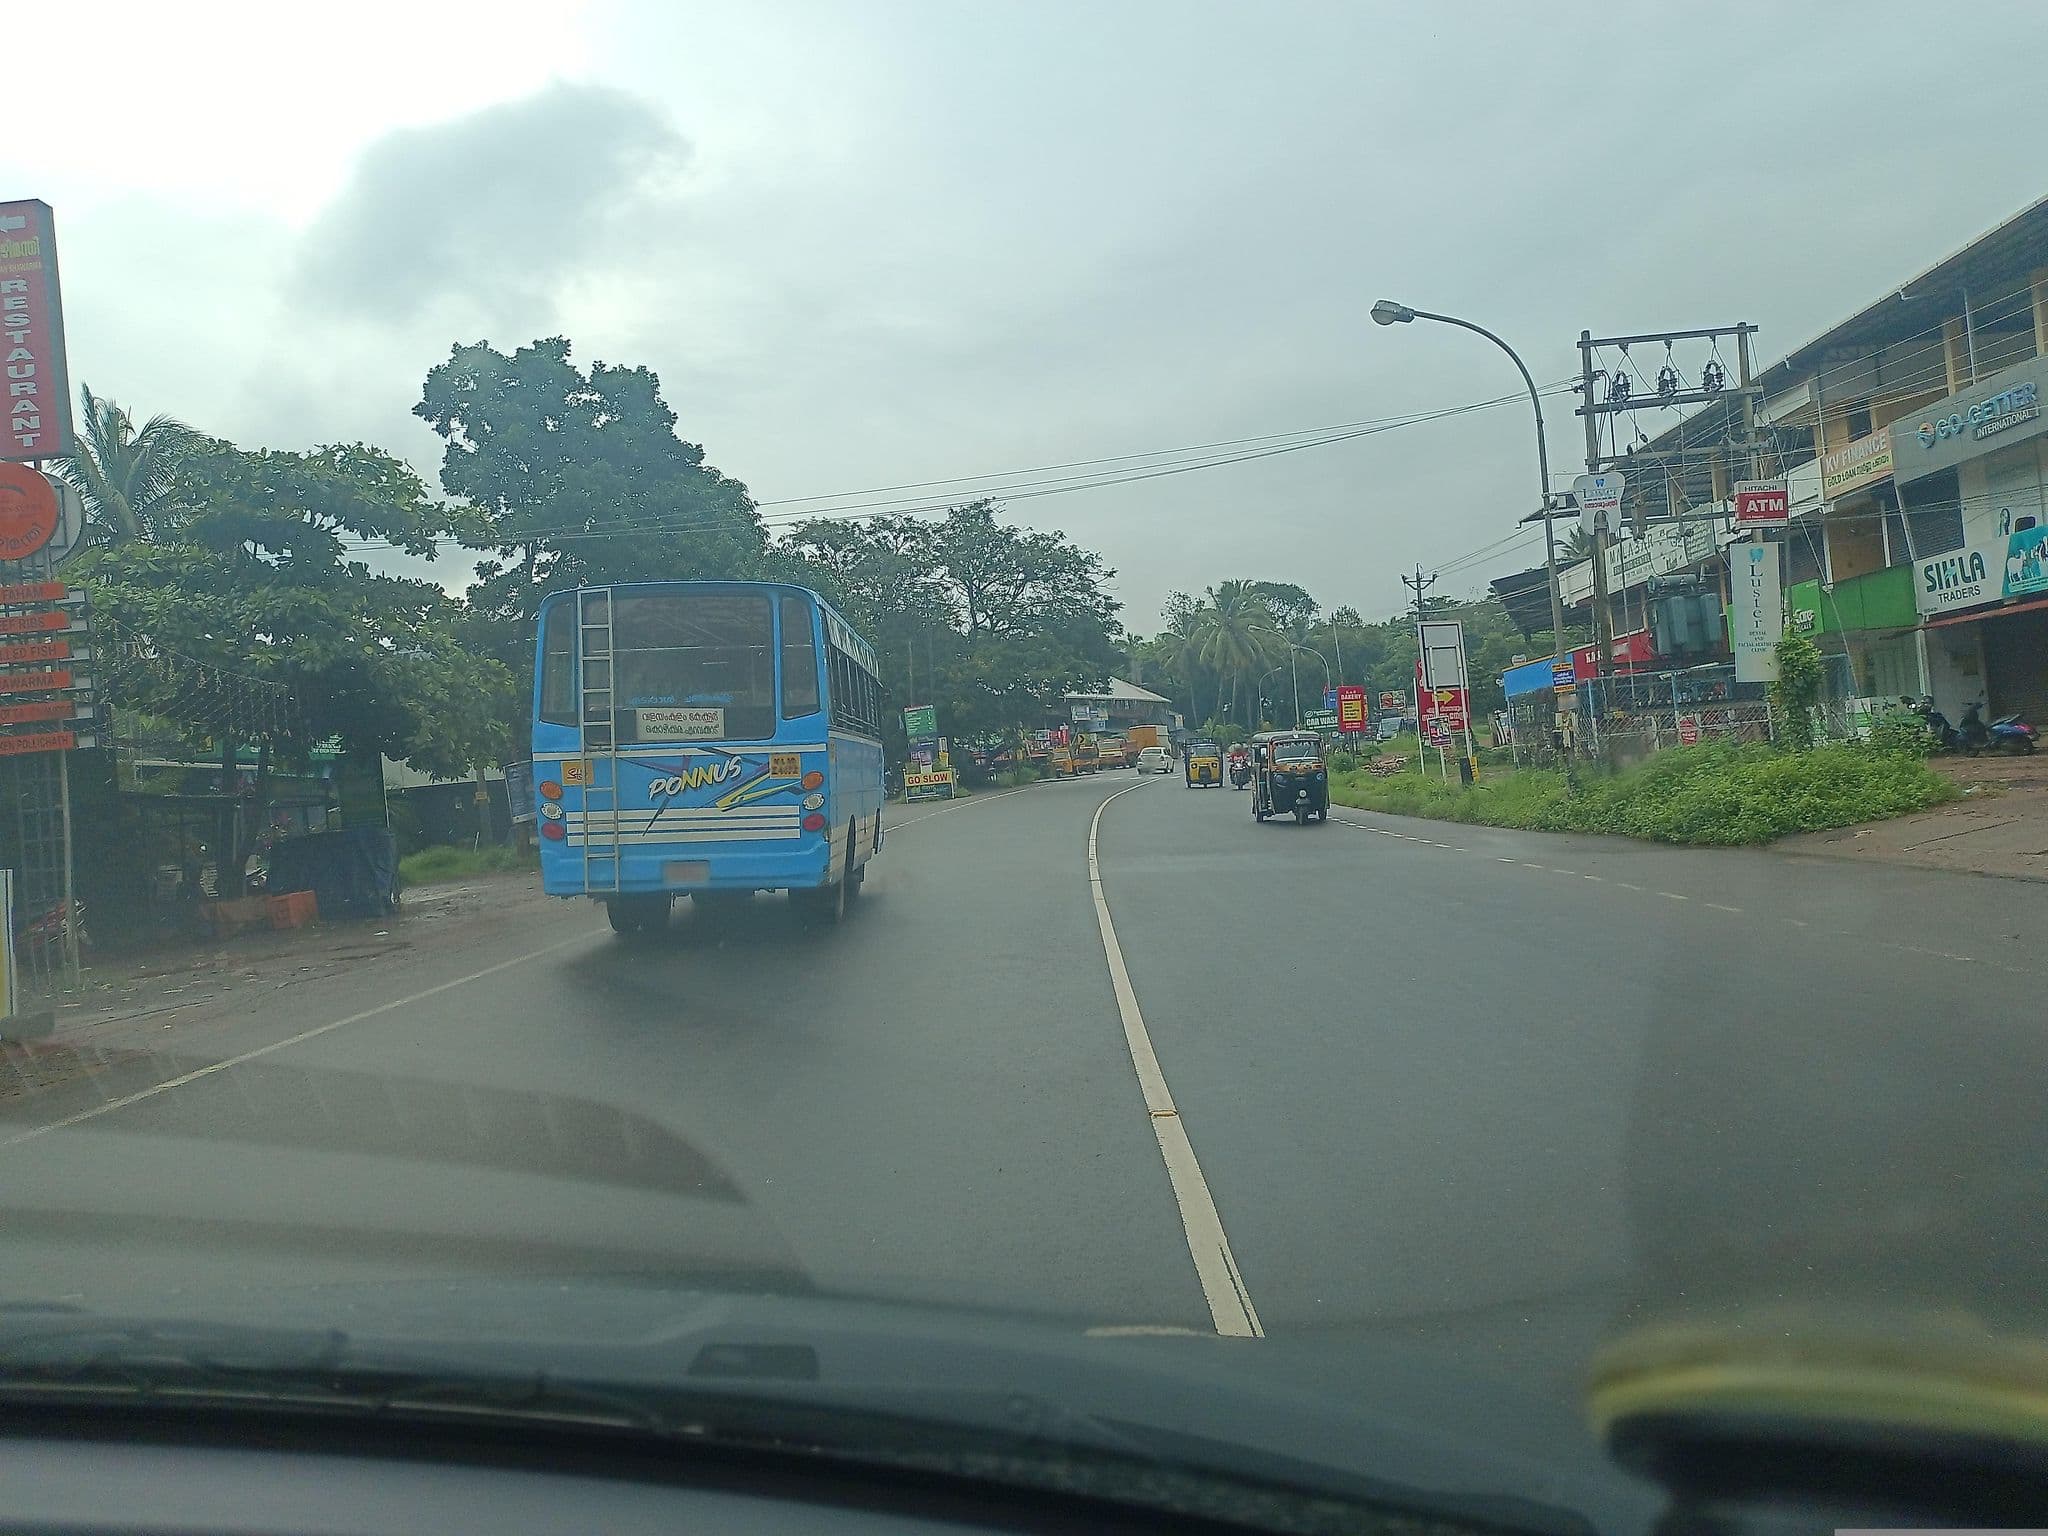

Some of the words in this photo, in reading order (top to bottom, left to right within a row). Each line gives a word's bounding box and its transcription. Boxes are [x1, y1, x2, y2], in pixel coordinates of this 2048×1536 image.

[1, 278, 41, 447] RESTAURANT
[1976, 408, 2034, 439] INTERNATIONAL
[1825, 453, 1839, 474] KV
[1842, 432, 1887, 467] FINANCE
[1746, 498, 1784, 513] ATM
[1938, 584, 1981, 604] TRADERS
[30, 644, 57, 659] FISH
[1306, 717, 1320, 727] CAR
[648, 756, 742, 800] PONNUS
[907, 775, 921, 785] GO
[923, 772, 948, 784] SLOW
